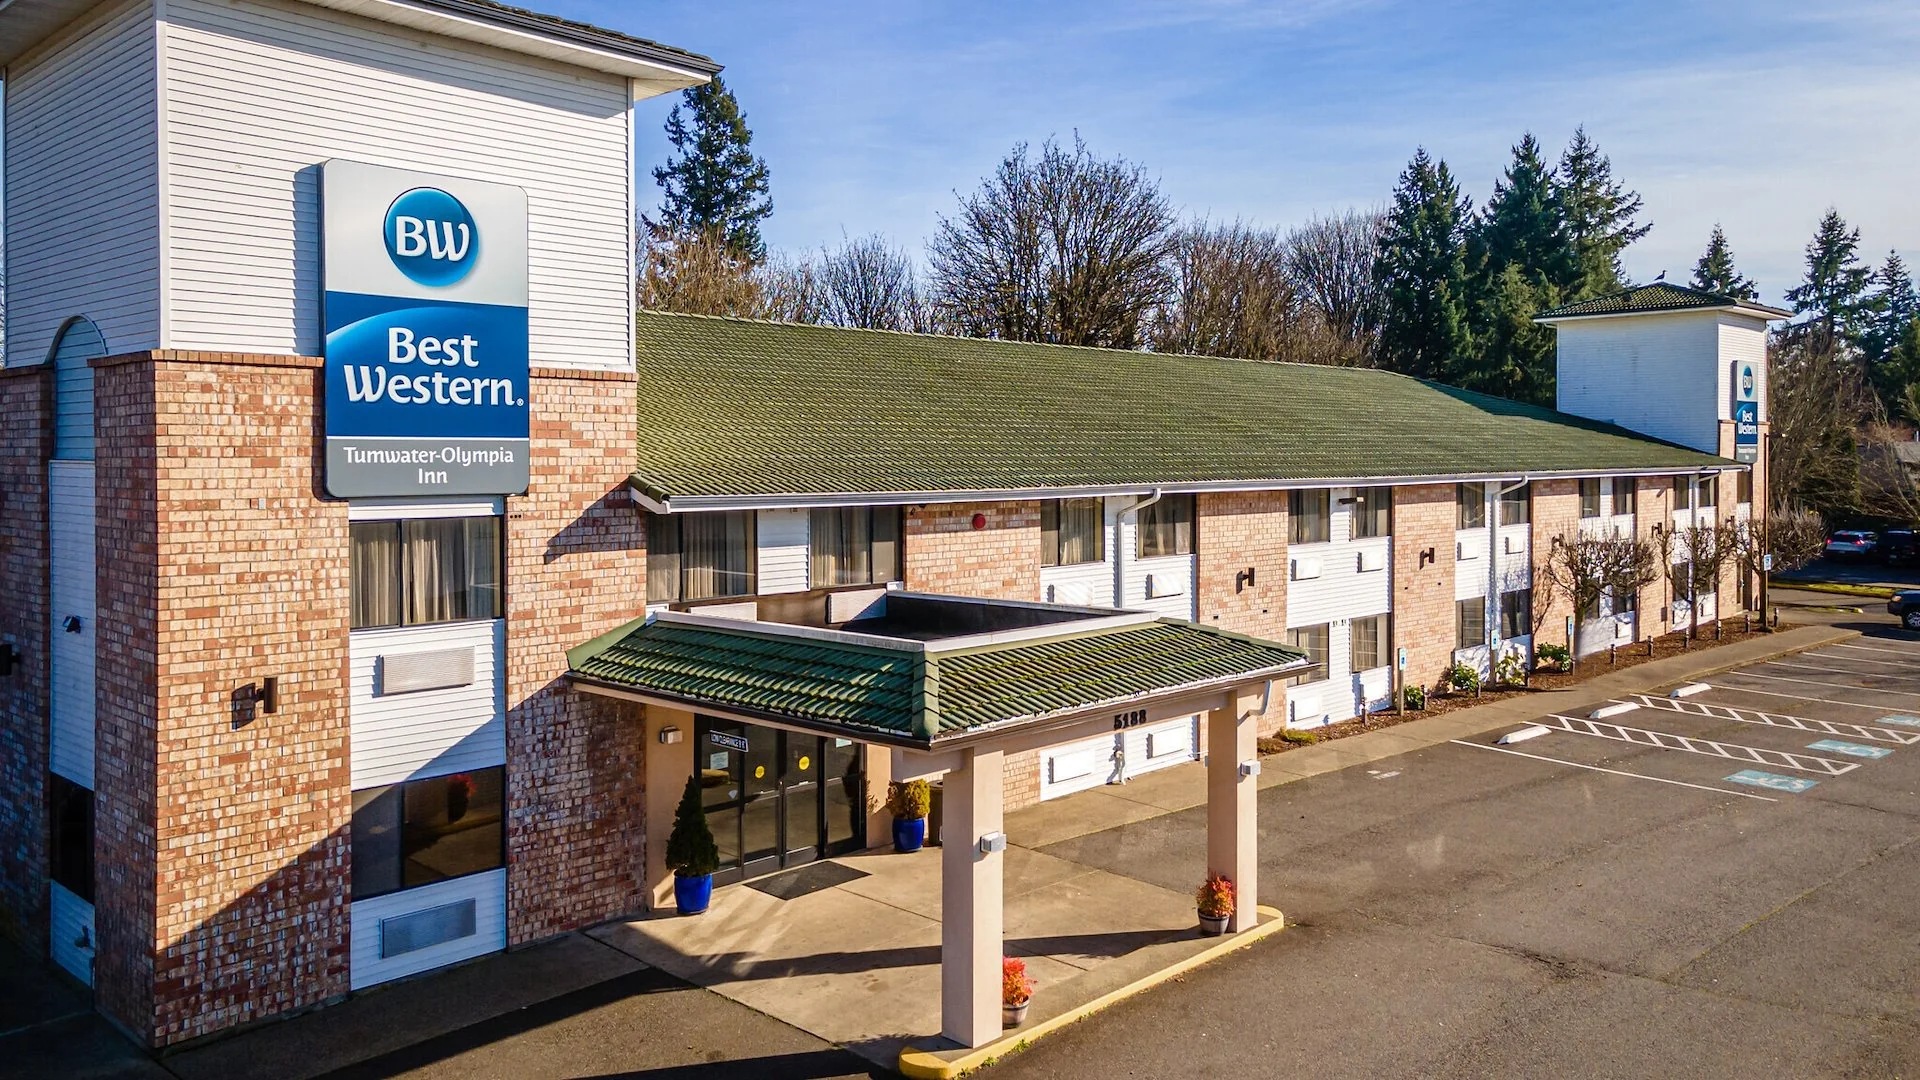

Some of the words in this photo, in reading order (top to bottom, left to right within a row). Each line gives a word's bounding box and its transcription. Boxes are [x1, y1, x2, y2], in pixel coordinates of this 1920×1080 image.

[395, 215, 470, 262] BW
[388, 326, 479, 368] Best
[343, 364, 516, 407] Western
[343, 446, 514, 467] Tumwater-Olympia
[418, 468, 448, 484] Inn
